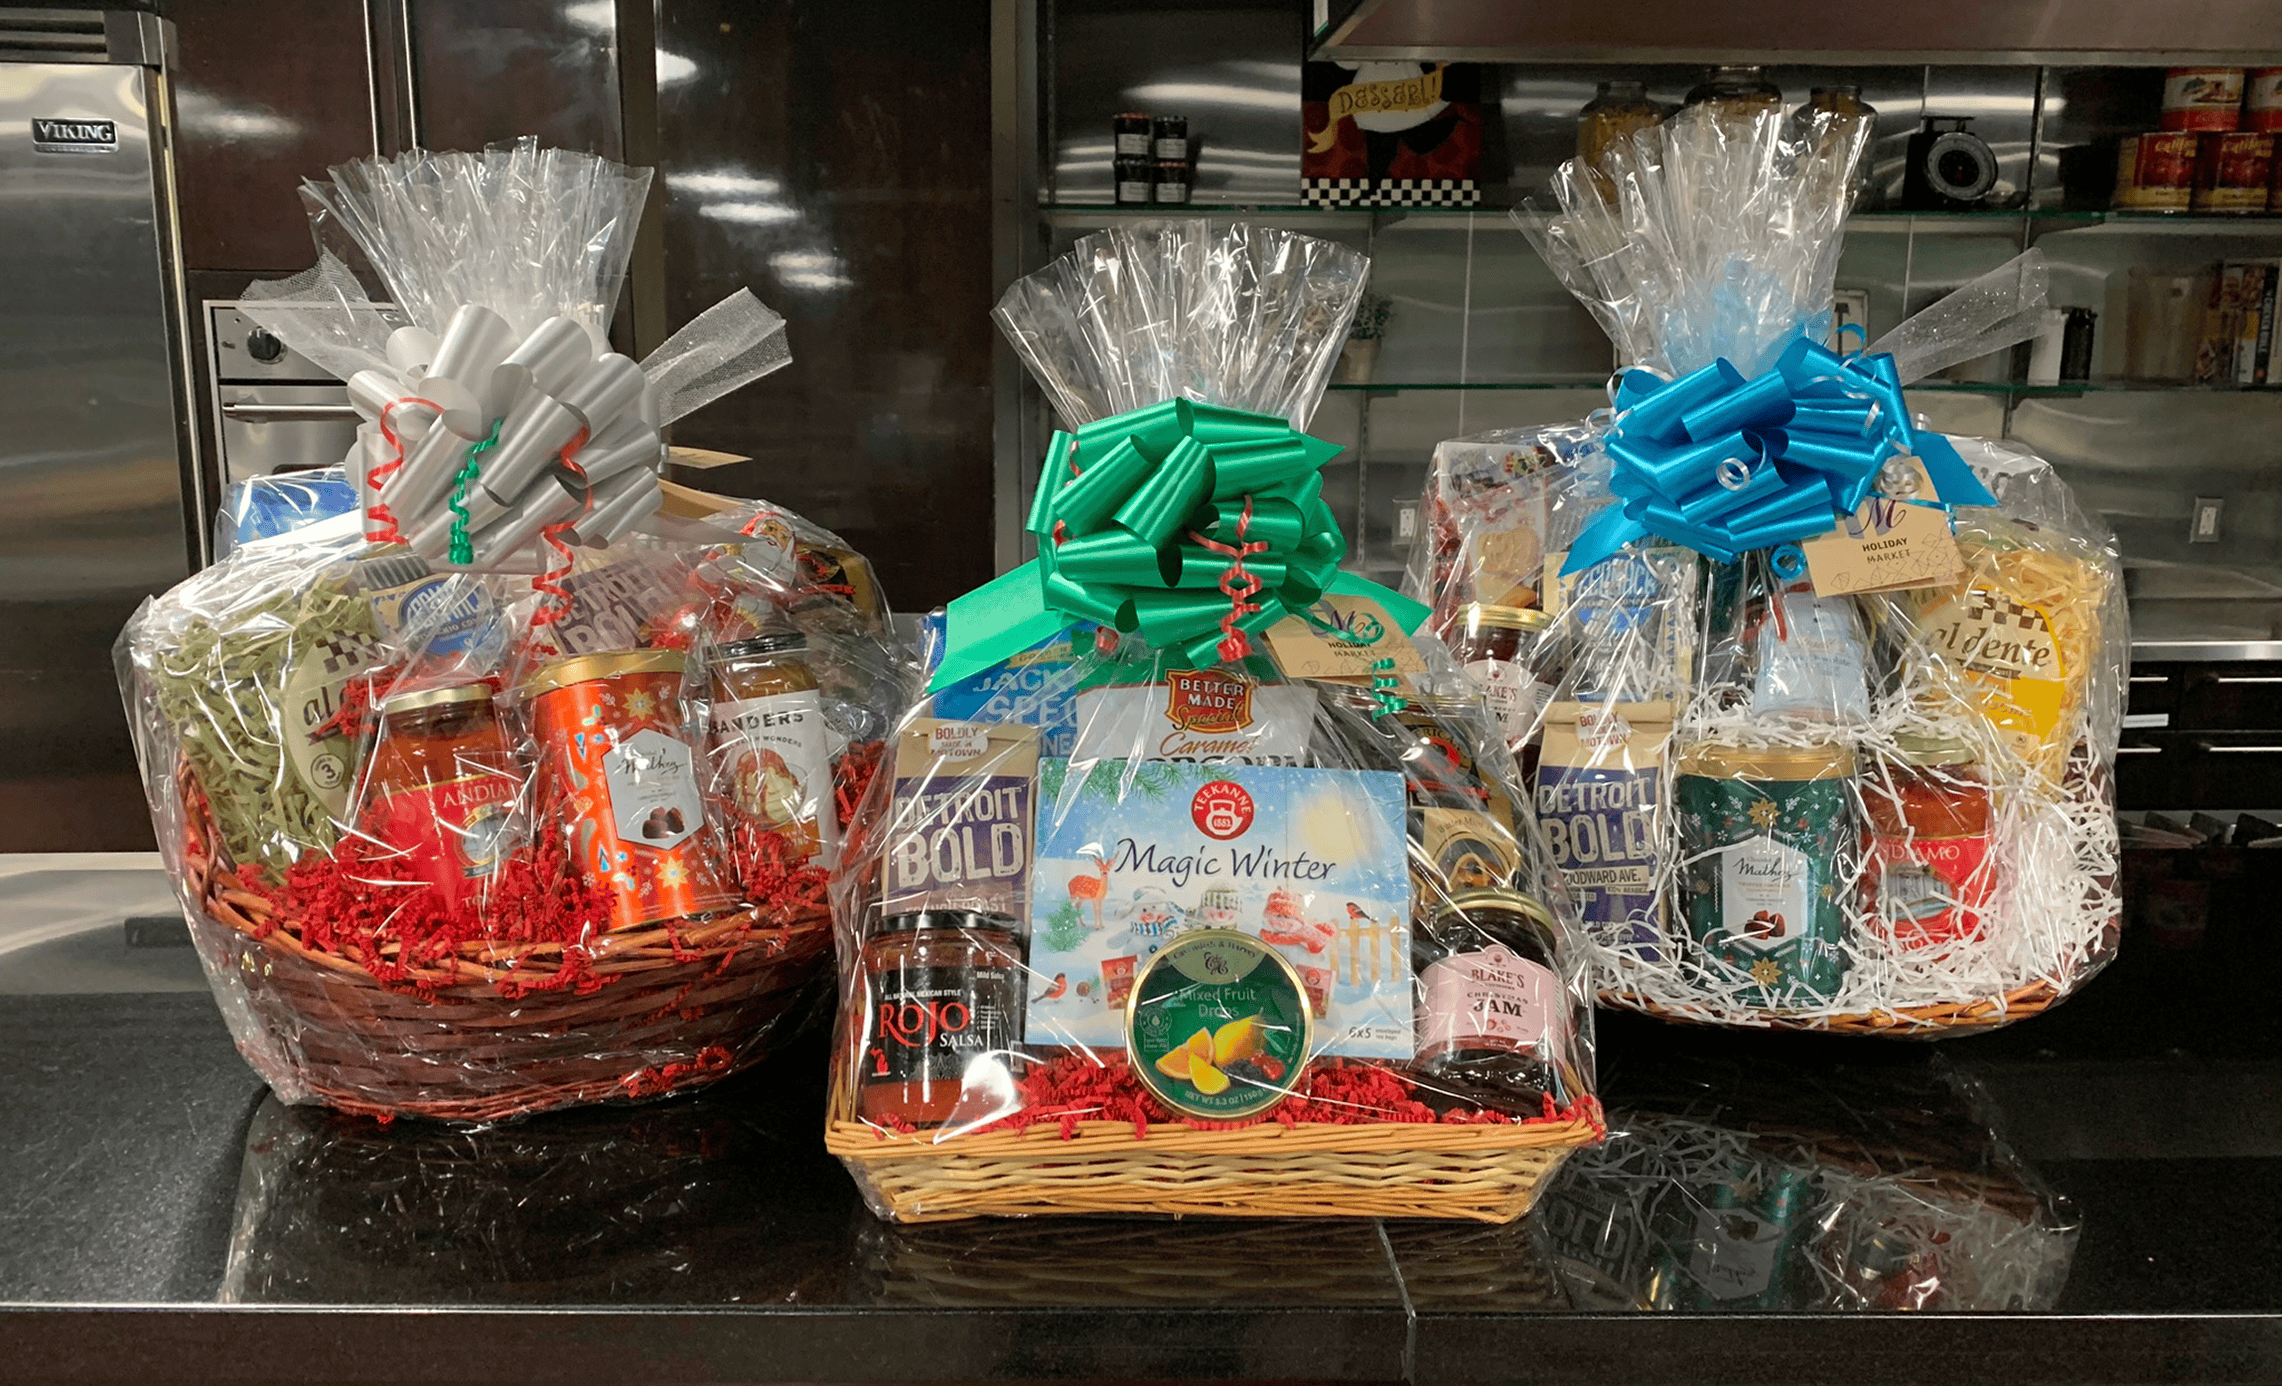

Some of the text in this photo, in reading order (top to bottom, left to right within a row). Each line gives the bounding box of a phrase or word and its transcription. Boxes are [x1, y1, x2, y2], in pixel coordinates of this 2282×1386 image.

[37, 121, 112, 141] VIKING
[1862, 537, 1908, 552] HOLIDAY
[1866, 549, 1910, 564] MARKET
[1334, 650, 1377, 658] MARKET
[1960, 626, 2051, 667] dente
[1179, 678, 1244, 696] BETTER
[1187, 693, 1235, 710] MADE
[709, 710, 804, 735] SANDERS
[1172, 701, 1246, 731] Special
[763, 735, 802, 748] WONDERS
[935, 727, 979, 740] BOLDLY
[1159, 731, 1259, 757] Caramel
[321, 763, 336, 779] 3
[1194, 783, 1252, 814] TEEKANNE
[1539, 777, 1651, 814] DETROIT
[895, 786, 1023, 829] DETROIT
[1540, 810, 1655, 865] BOLD
[896, 822, 1024, 889] BOLD
[1114, 837, 1337, 887] Magic Winter
[1619, 868, 1642, 882] AVE.
[976, 970, 990, 979] Mild
[1470, 968, 1525, 989] BLAKE'S
[916, 990, 943, 999] MEXICAN
[943, 989, 962, 997] STYLE
[1179, 988, 1257, 1001] Mixed Fruit
[1198, 1003, 1240, 1019] Drops
[1473, 999, 1523, 1018] JAM
[878, 1001, 971, 1048] ROJO
